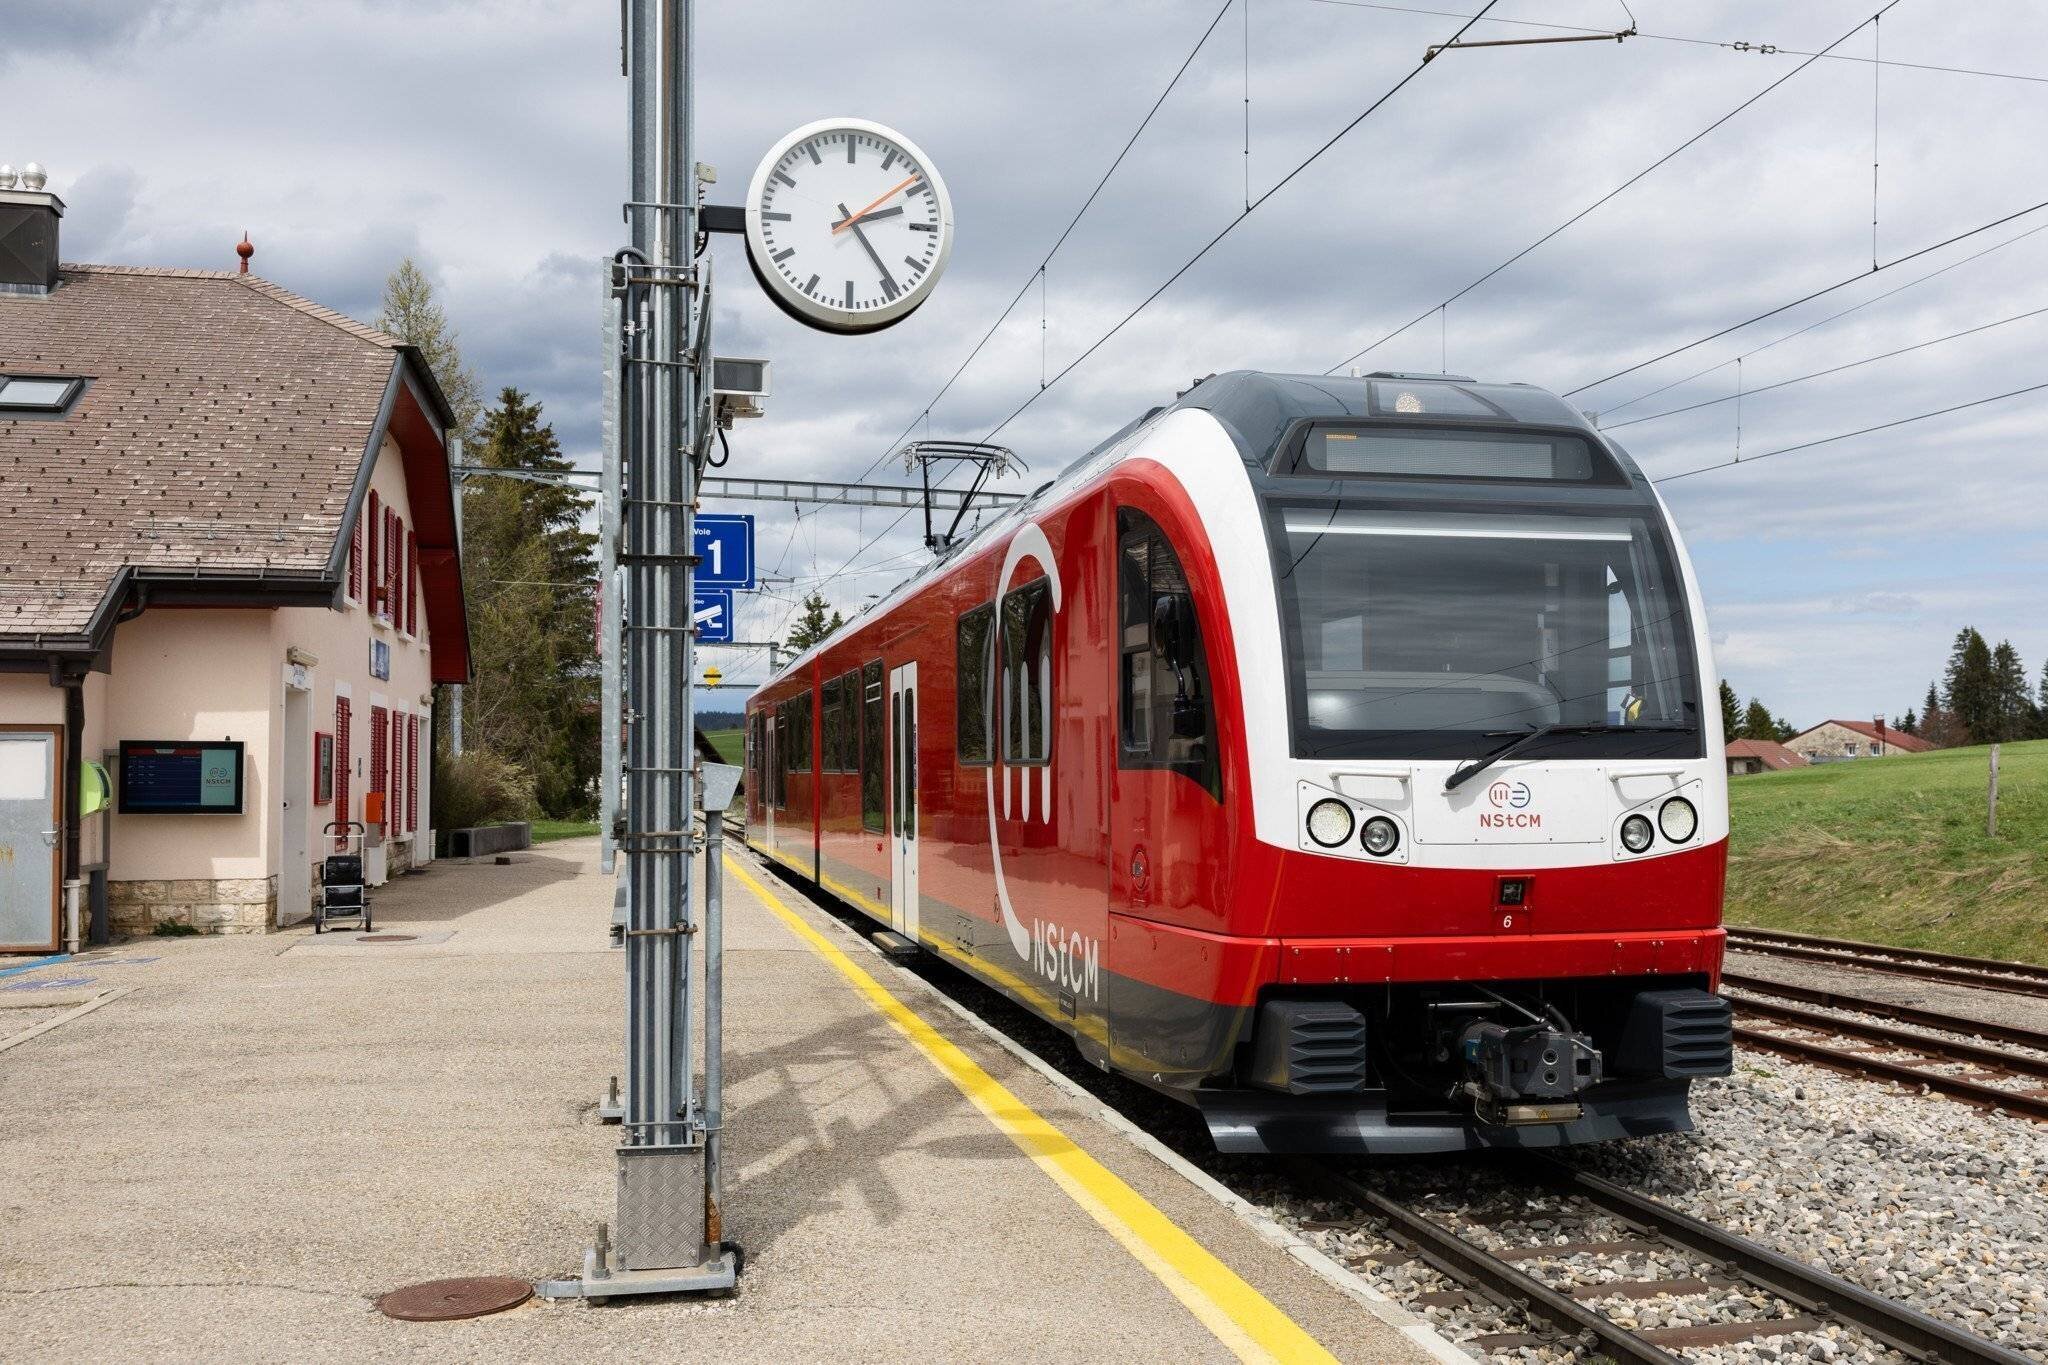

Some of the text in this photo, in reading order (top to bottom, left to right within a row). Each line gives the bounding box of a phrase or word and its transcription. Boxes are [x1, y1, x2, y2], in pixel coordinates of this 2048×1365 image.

[707, 539, 722, 575] 1
[1480, 813, 1541, 828] NStCM
[1503, 915, 1512, 928] 6
[1034, 917, 1098, 1003] NStCM
